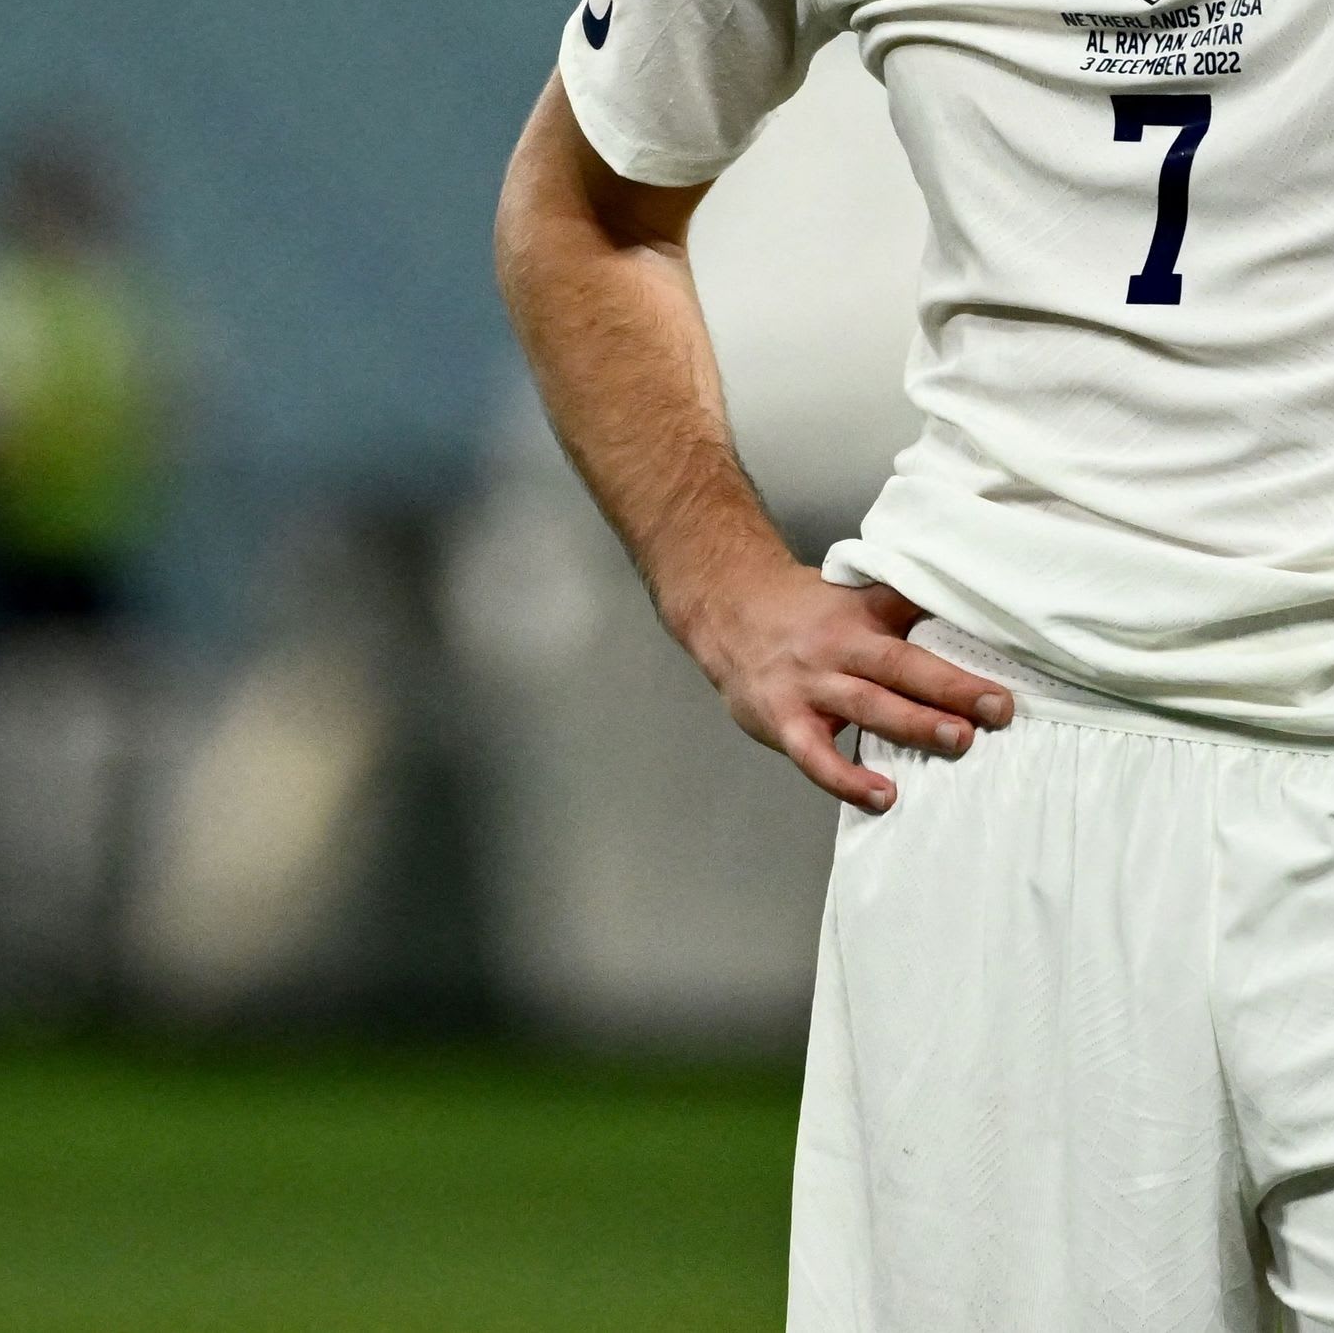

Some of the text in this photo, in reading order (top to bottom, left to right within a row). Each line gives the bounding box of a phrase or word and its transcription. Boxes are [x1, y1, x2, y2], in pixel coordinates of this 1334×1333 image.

[1060, 5, 1201, 29] NETHERLANDS
[1205, 1, 1226, 24] VS
[1086, 30, 1109, 54] AL
[1191, 23, 1243, 47] QATAR
[1080, 51, 1242, 76] 3 DECEMBER 2022
[1110, 94, 1212, 305] 7
